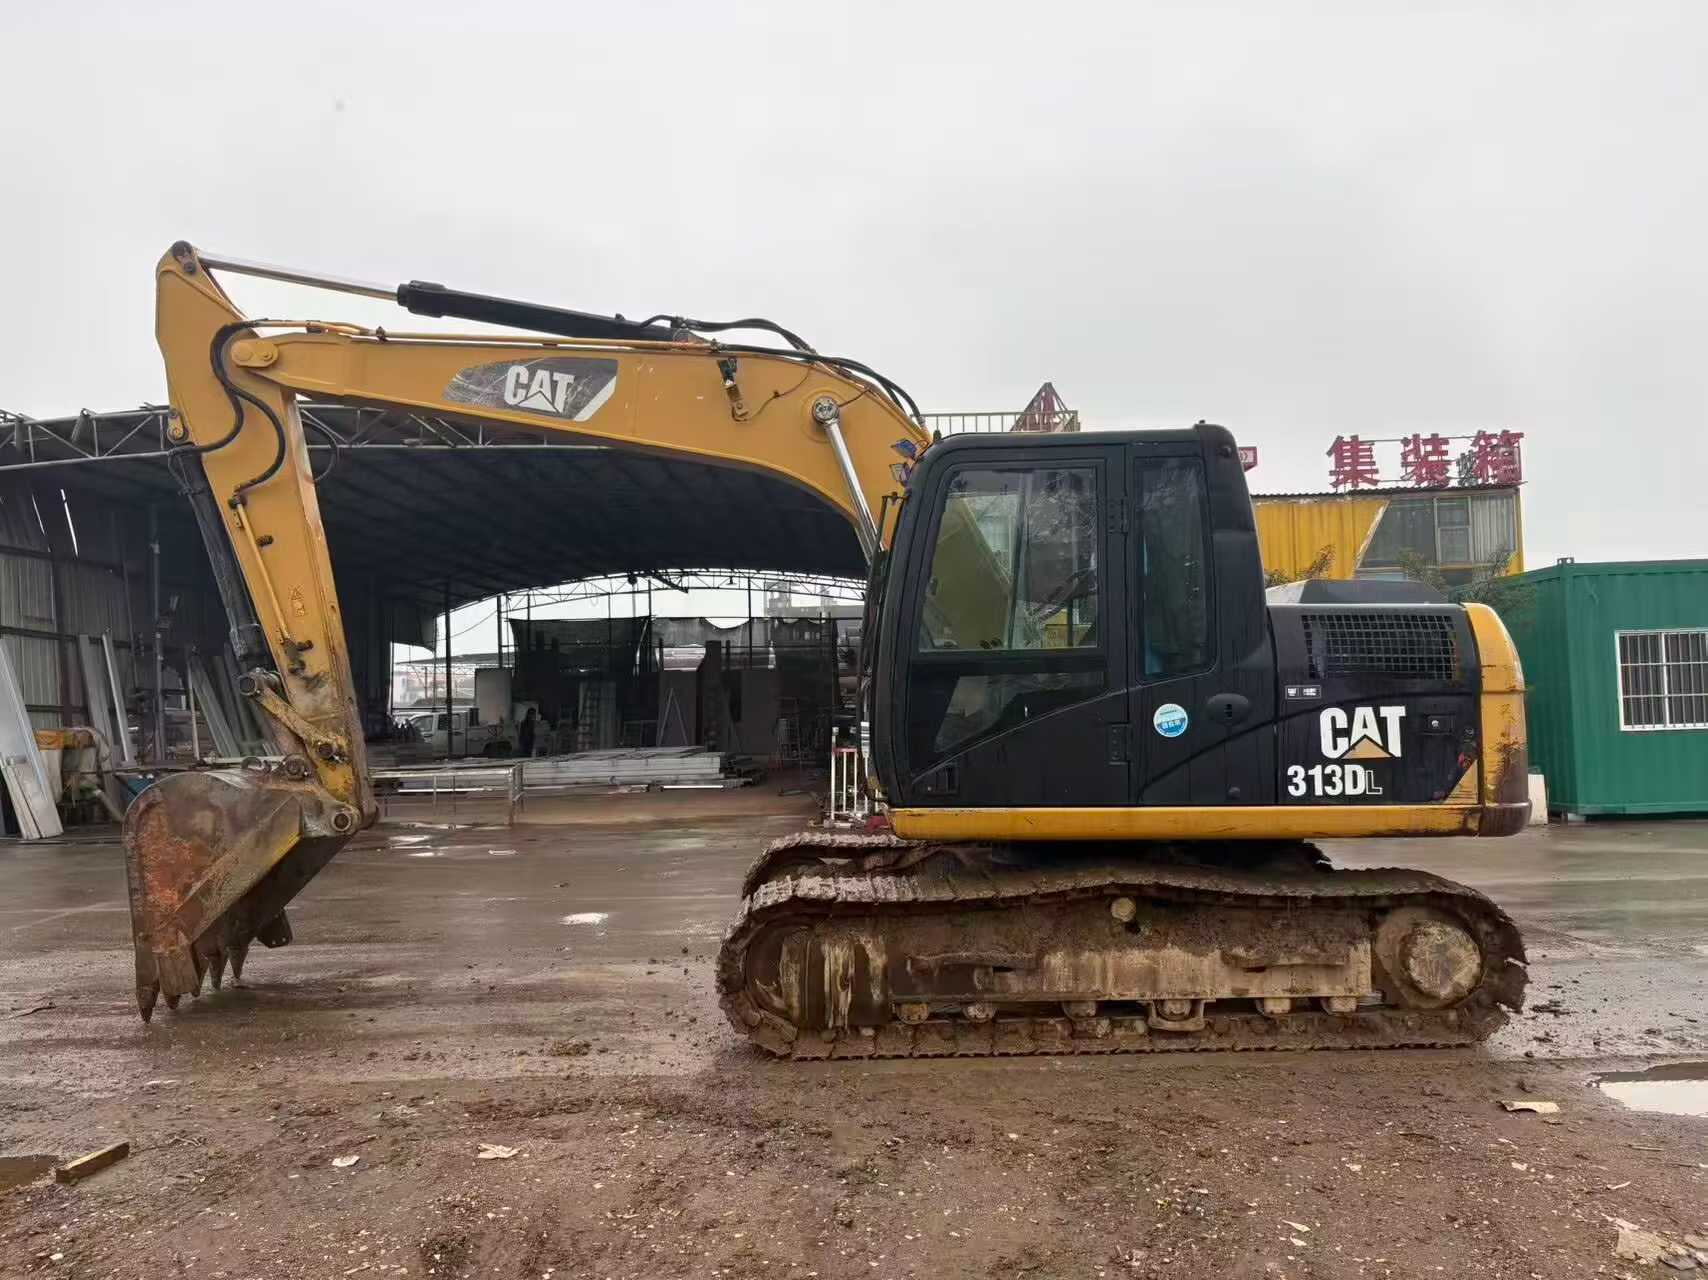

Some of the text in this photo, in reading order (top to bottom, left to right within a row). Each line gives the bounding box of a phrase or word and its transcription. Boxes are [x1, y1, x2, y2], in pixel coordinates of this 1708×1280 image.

[504, 365, 576, 414] CAT
[1326, 430, 1525, 488] 集装箱
[1319, 705, 1406, 759] CAT
